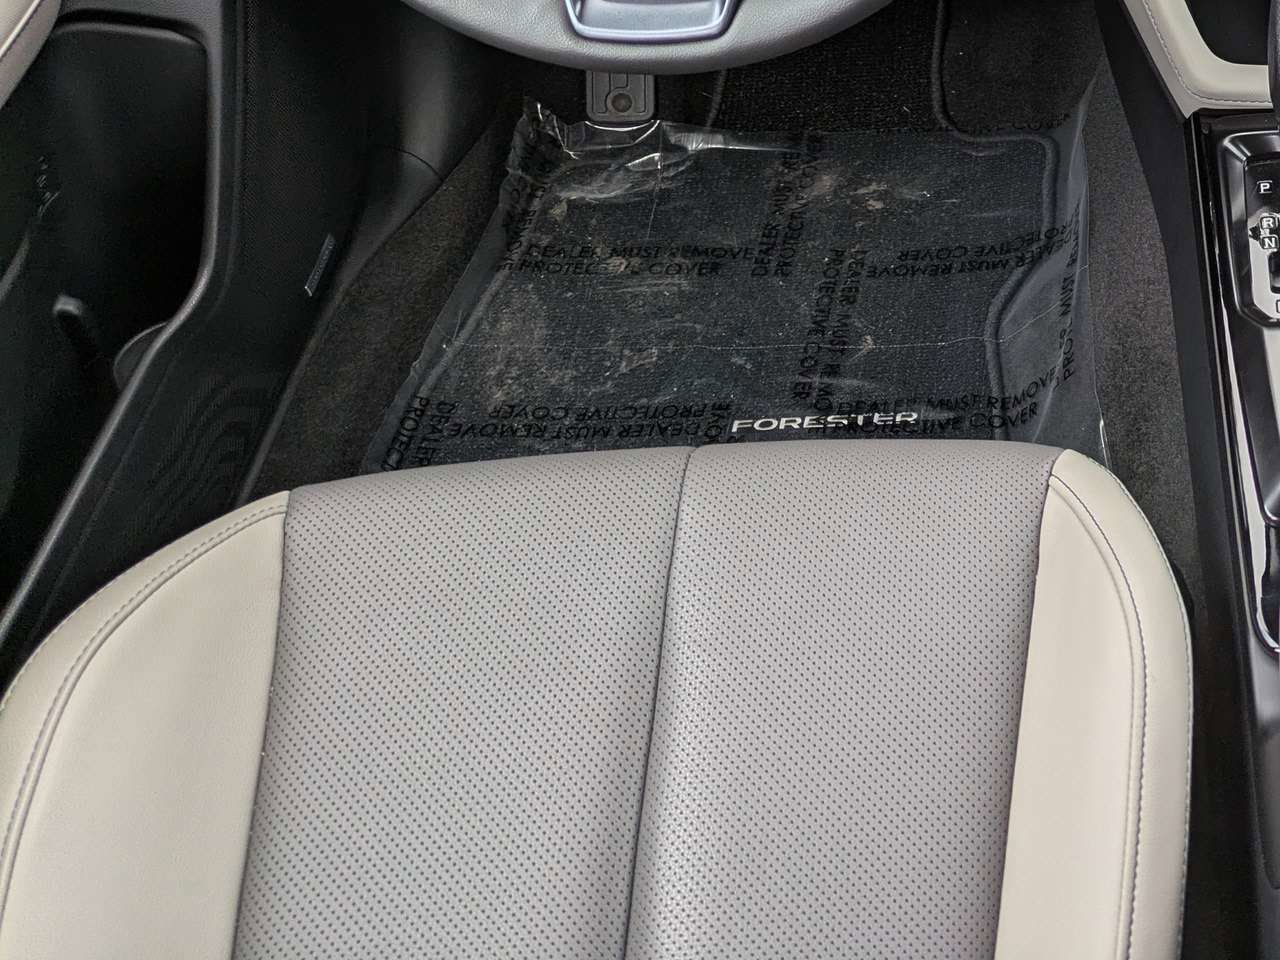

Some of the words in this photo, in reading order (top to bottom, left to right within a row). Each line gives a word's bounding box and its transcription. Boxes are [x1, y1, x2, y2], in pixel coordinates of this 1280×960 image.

[1260, 182, 1270, 194] P
[1262, 218, 1274, 228] R
[1264, 238, 1276, 248] N
[610, 245, 662, 259] MUST
[898, 246, 968, 261] COVER
[649, 261, 722, 276] COVER
[866, 263, 952, 278] REMOVE
[958, 259, 1009, 274] MUST
[489, 404, 569, 420] COVER
[575, 403, 707, 422] PROTECTIVE
[970, 402, 1038, 429] COVER
[731, 412, 918, 432] FORESTER
[552, 424, 610, 440] MUST
